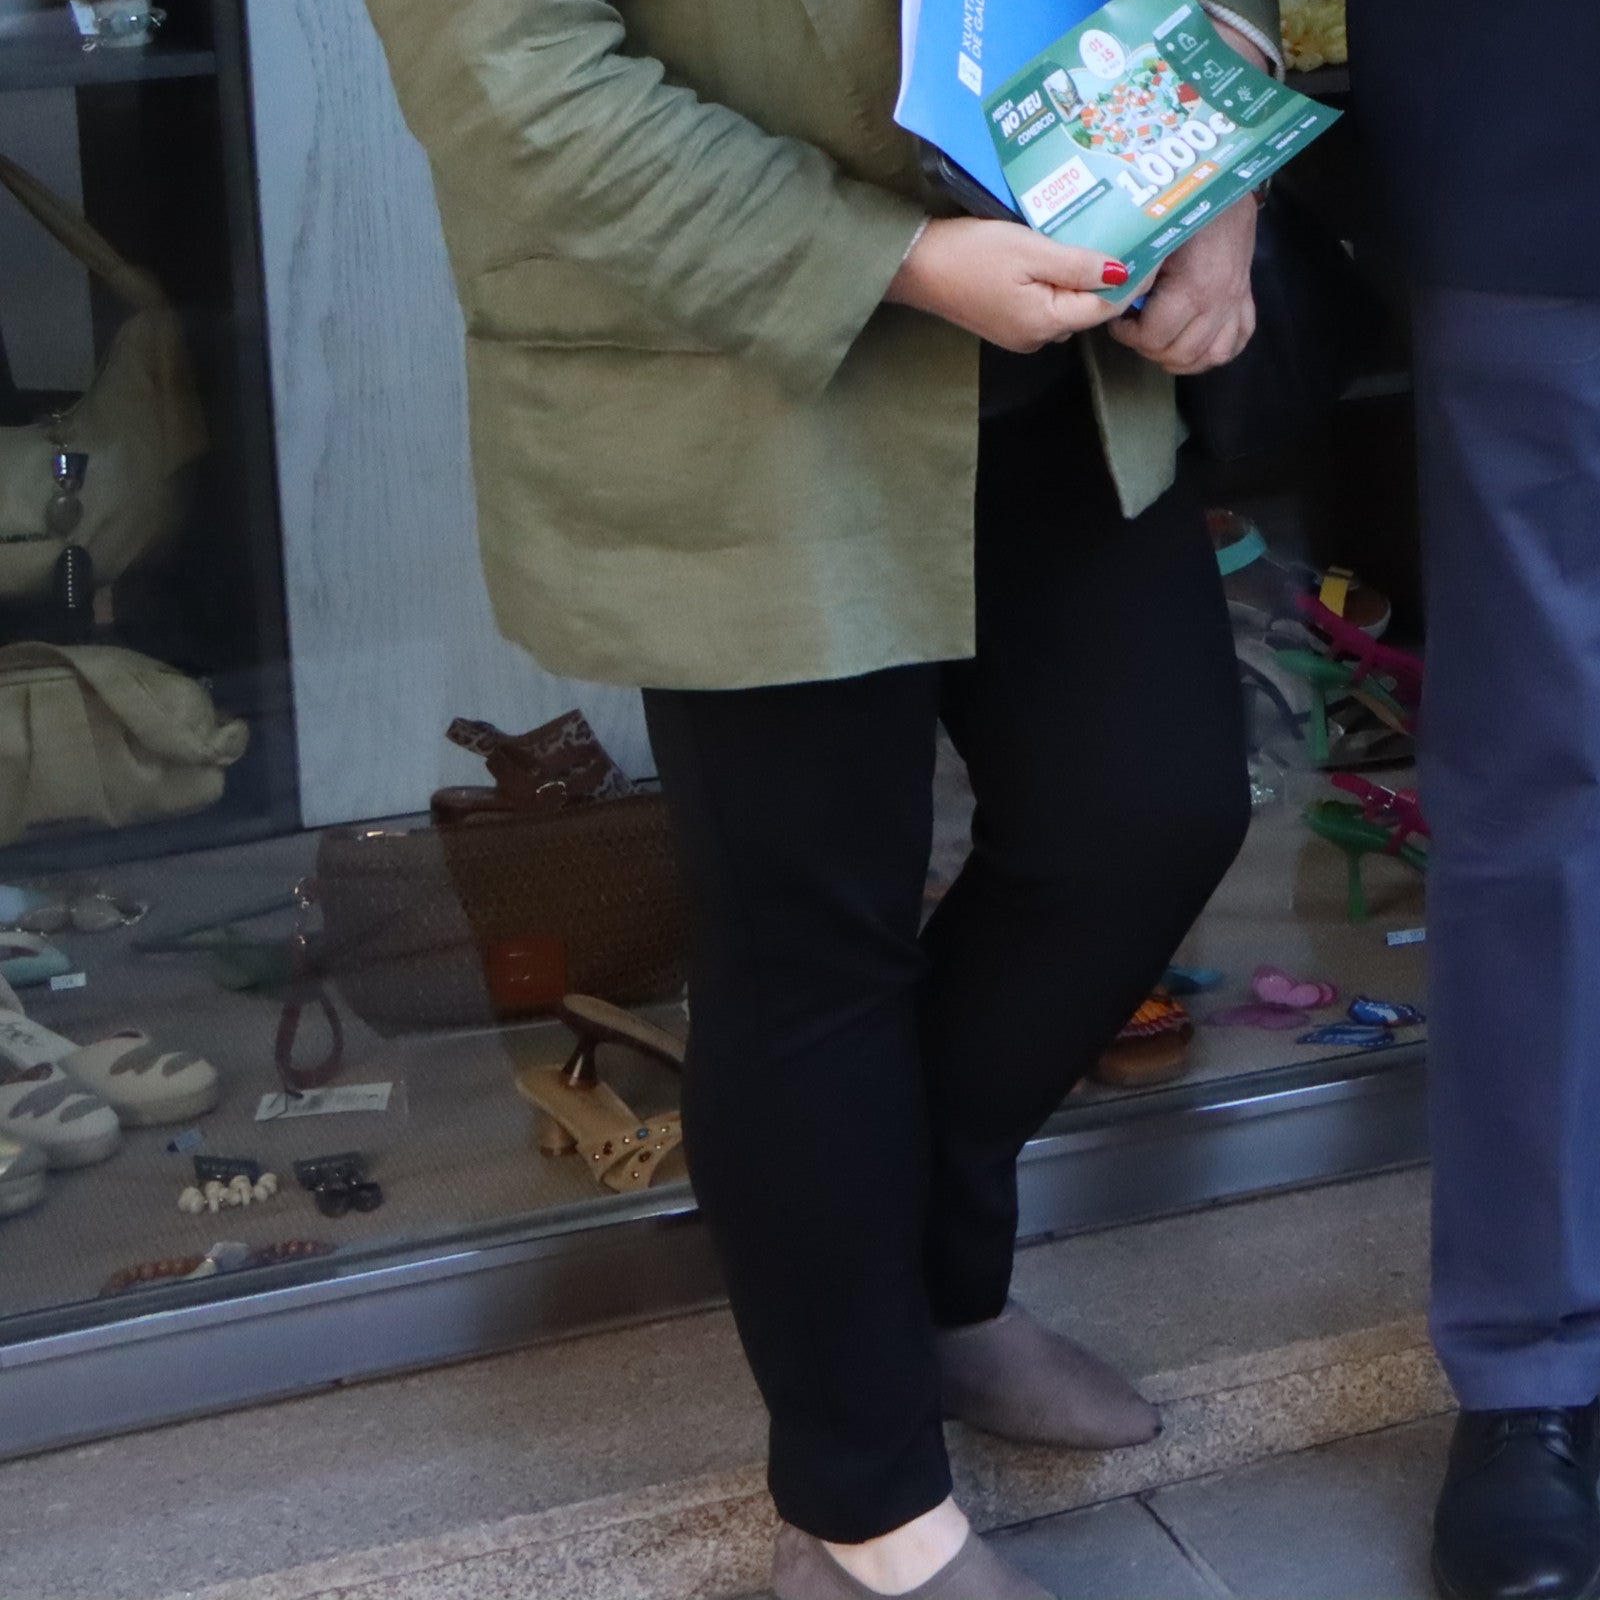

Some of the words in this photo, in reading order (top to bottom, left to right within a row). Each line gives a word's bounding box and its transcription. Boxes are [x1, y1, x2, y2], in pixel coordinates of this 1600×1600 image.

[972, 33, 983, 60] DE
[992, 99, 1015, 123] MERCA
[1001, 111, 1020, 138] NO
[1017, 90, 1042, 120] TEU
[1018, 112, 1056, 146] COMERCIO
[1116, 112, 1236, 207] 1.000€
[1033, 196, 1042, 208] O
[1042, 167, 1080, 201] COUTO
